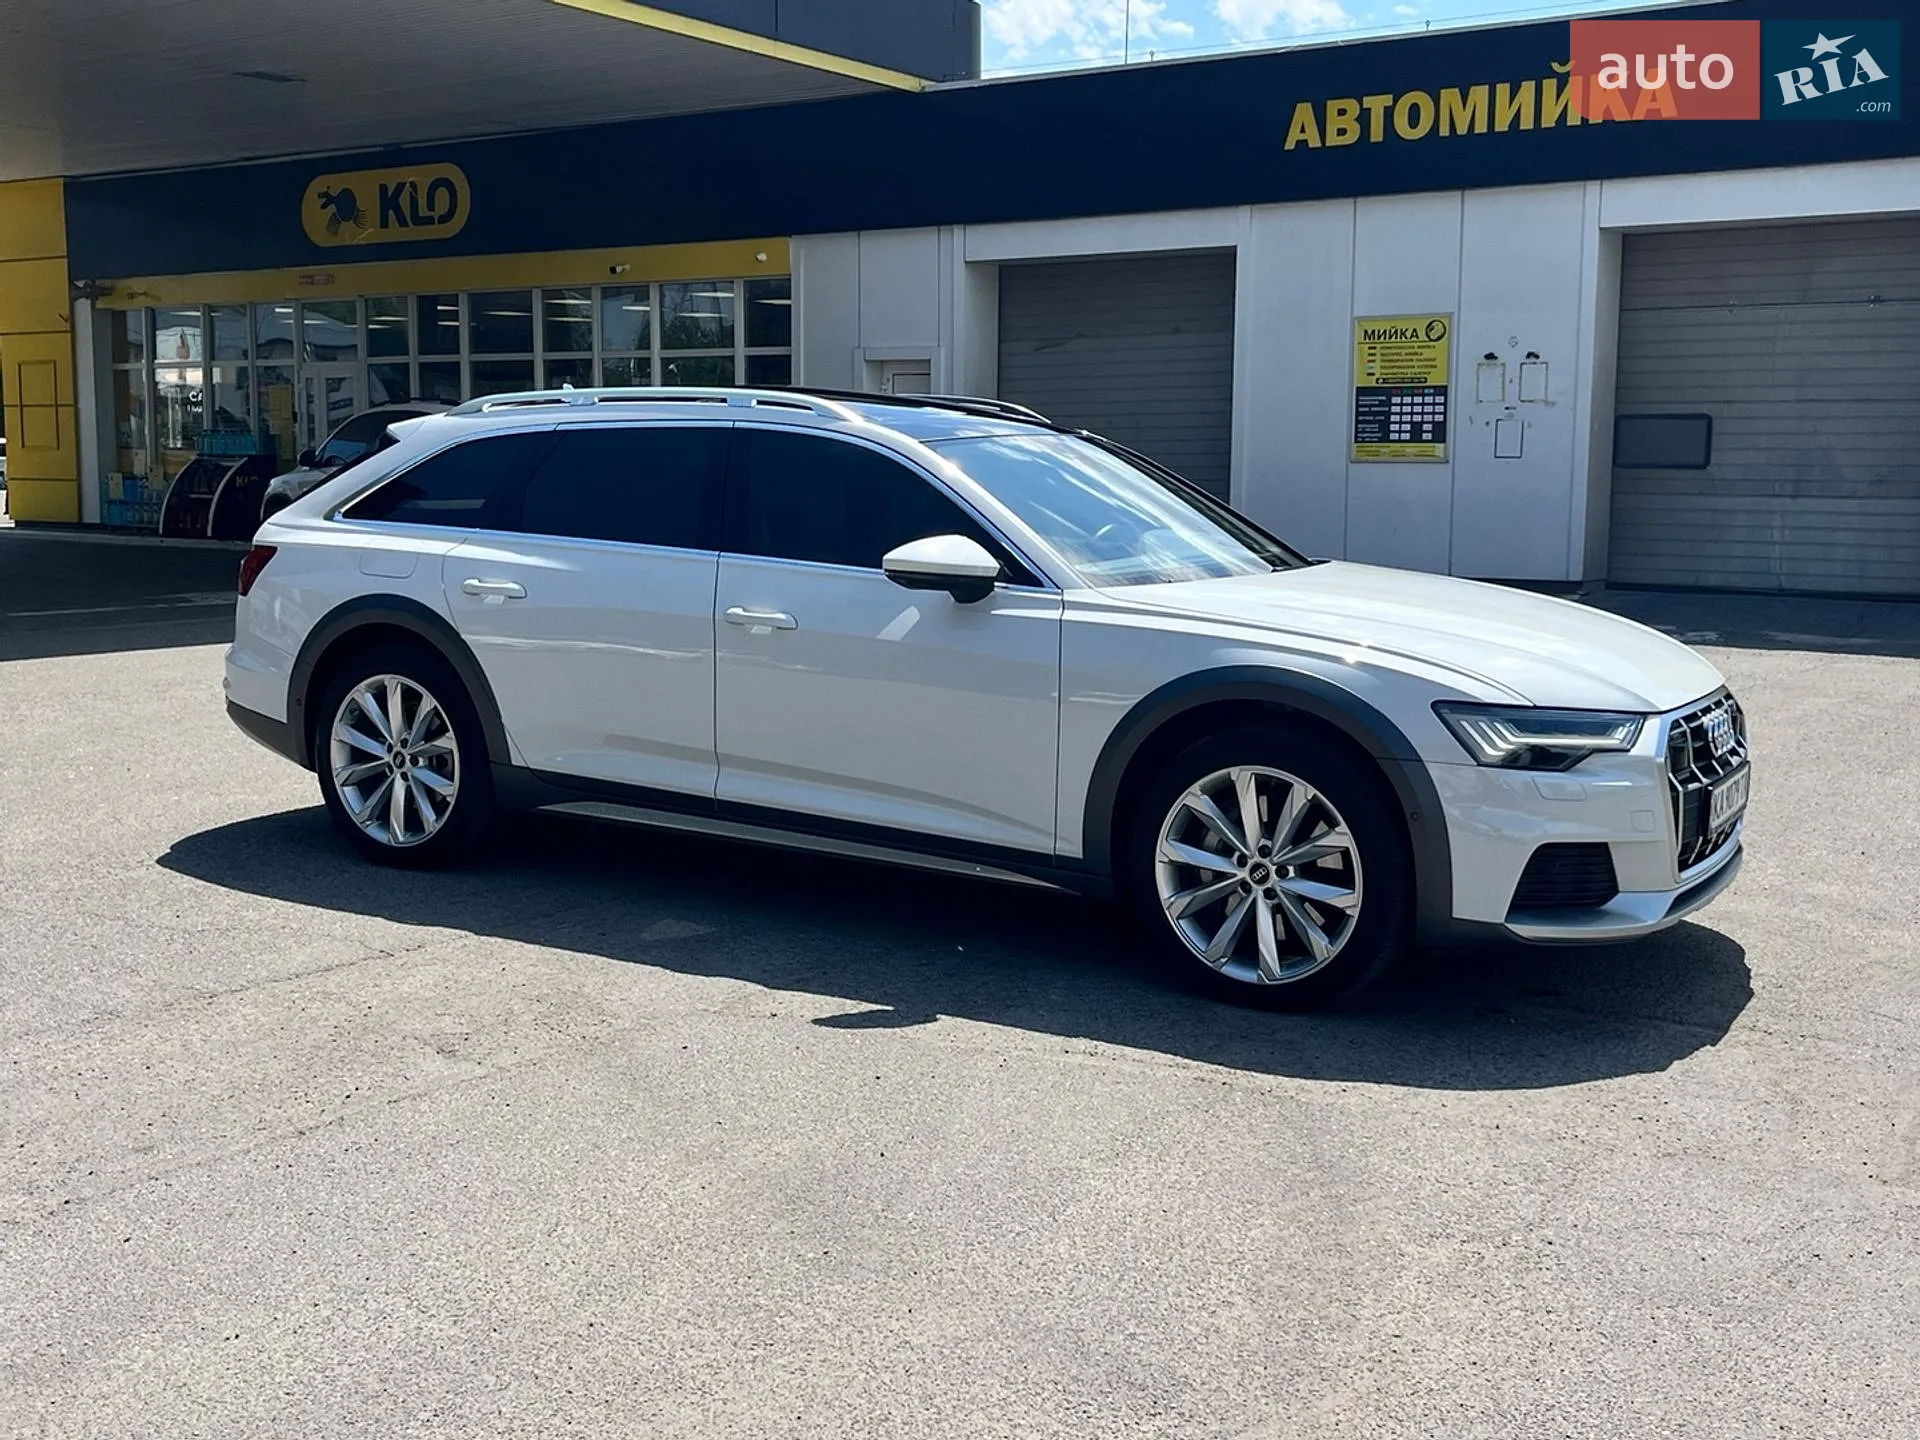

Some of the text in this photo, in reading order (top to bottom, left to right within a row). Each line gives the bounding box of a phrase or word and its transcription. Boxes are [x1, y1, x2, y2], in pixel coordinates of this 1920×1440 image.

[1284, 62, 1678, 151] АВТОМИЙКА
[379, 176, 459, 229] KLO
[1363, 326, 1420, 341] МИЙКА
